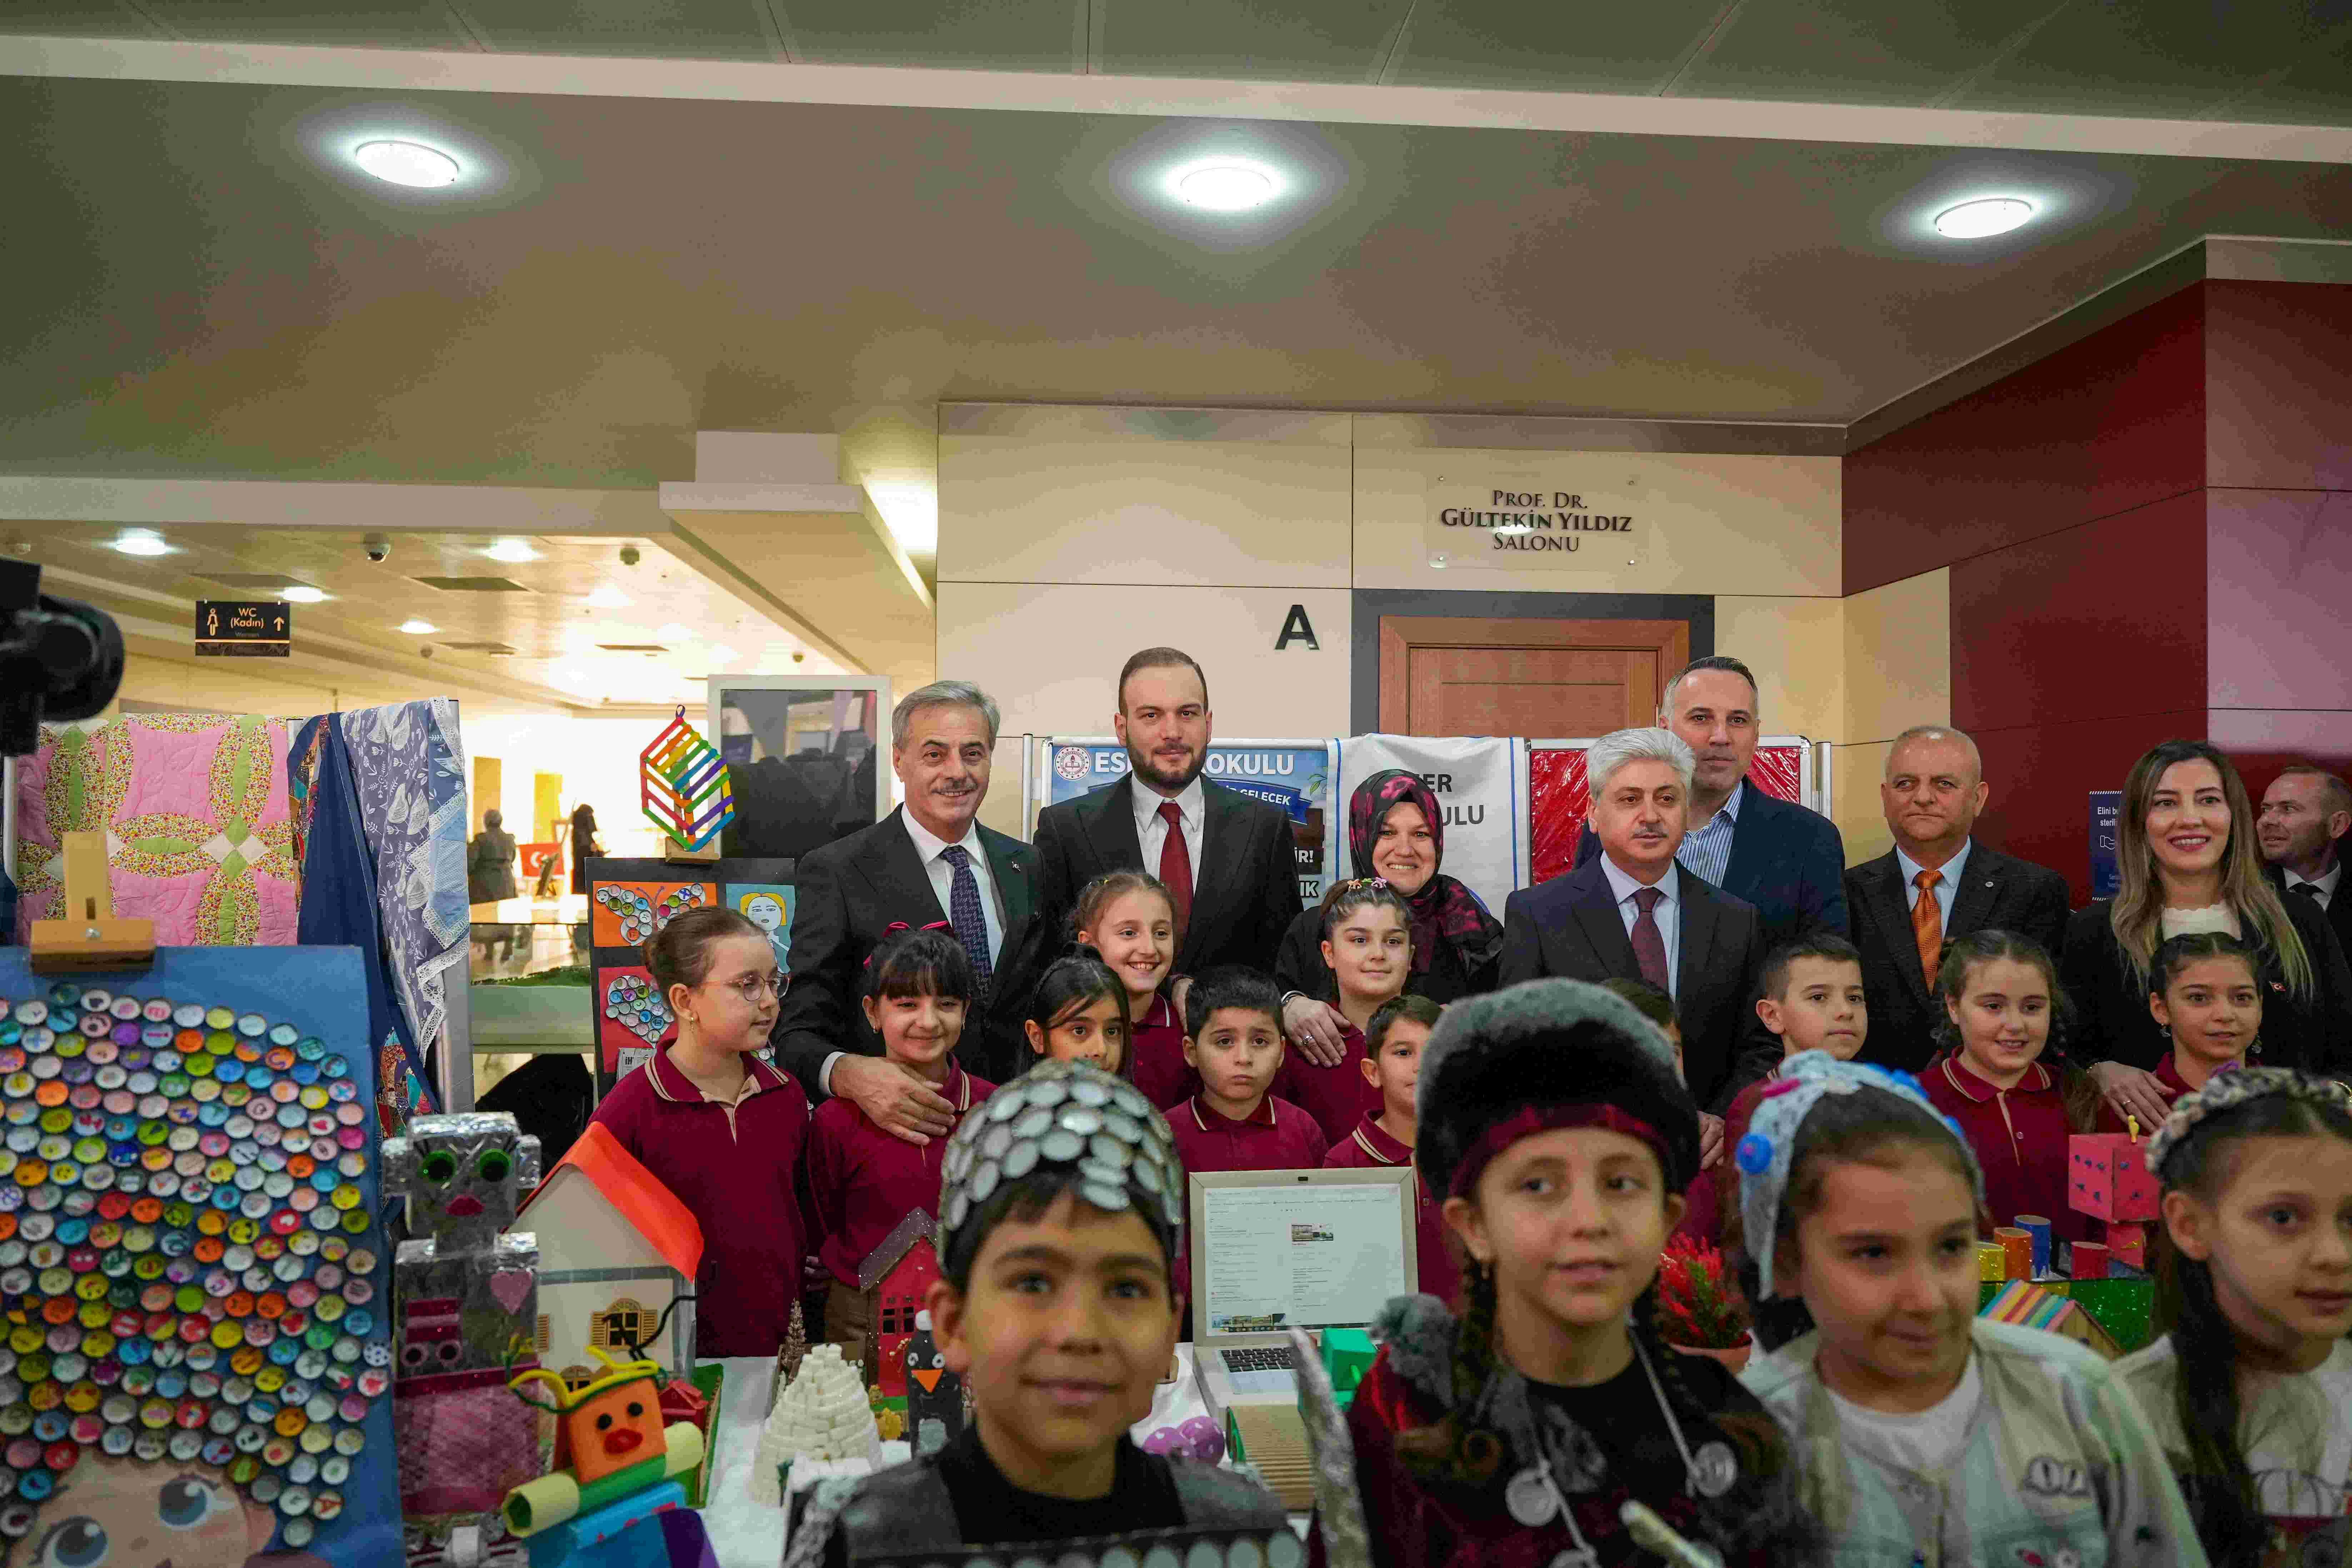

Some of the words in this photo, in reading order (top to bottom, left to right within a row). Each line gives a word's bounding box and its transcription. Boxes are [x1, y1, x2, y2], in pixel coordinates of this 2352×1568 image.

[1441, 508, 1552, 529] GÜLTEKİN
[1558, 512, 1632, 532] YILDIZ
[1494, 533, 1580, 552] SALONU
[238, 607, 257, 617] WC
[230, 617, 264, 628] (Kadın)
[1274, 604, 1320, 650] A
